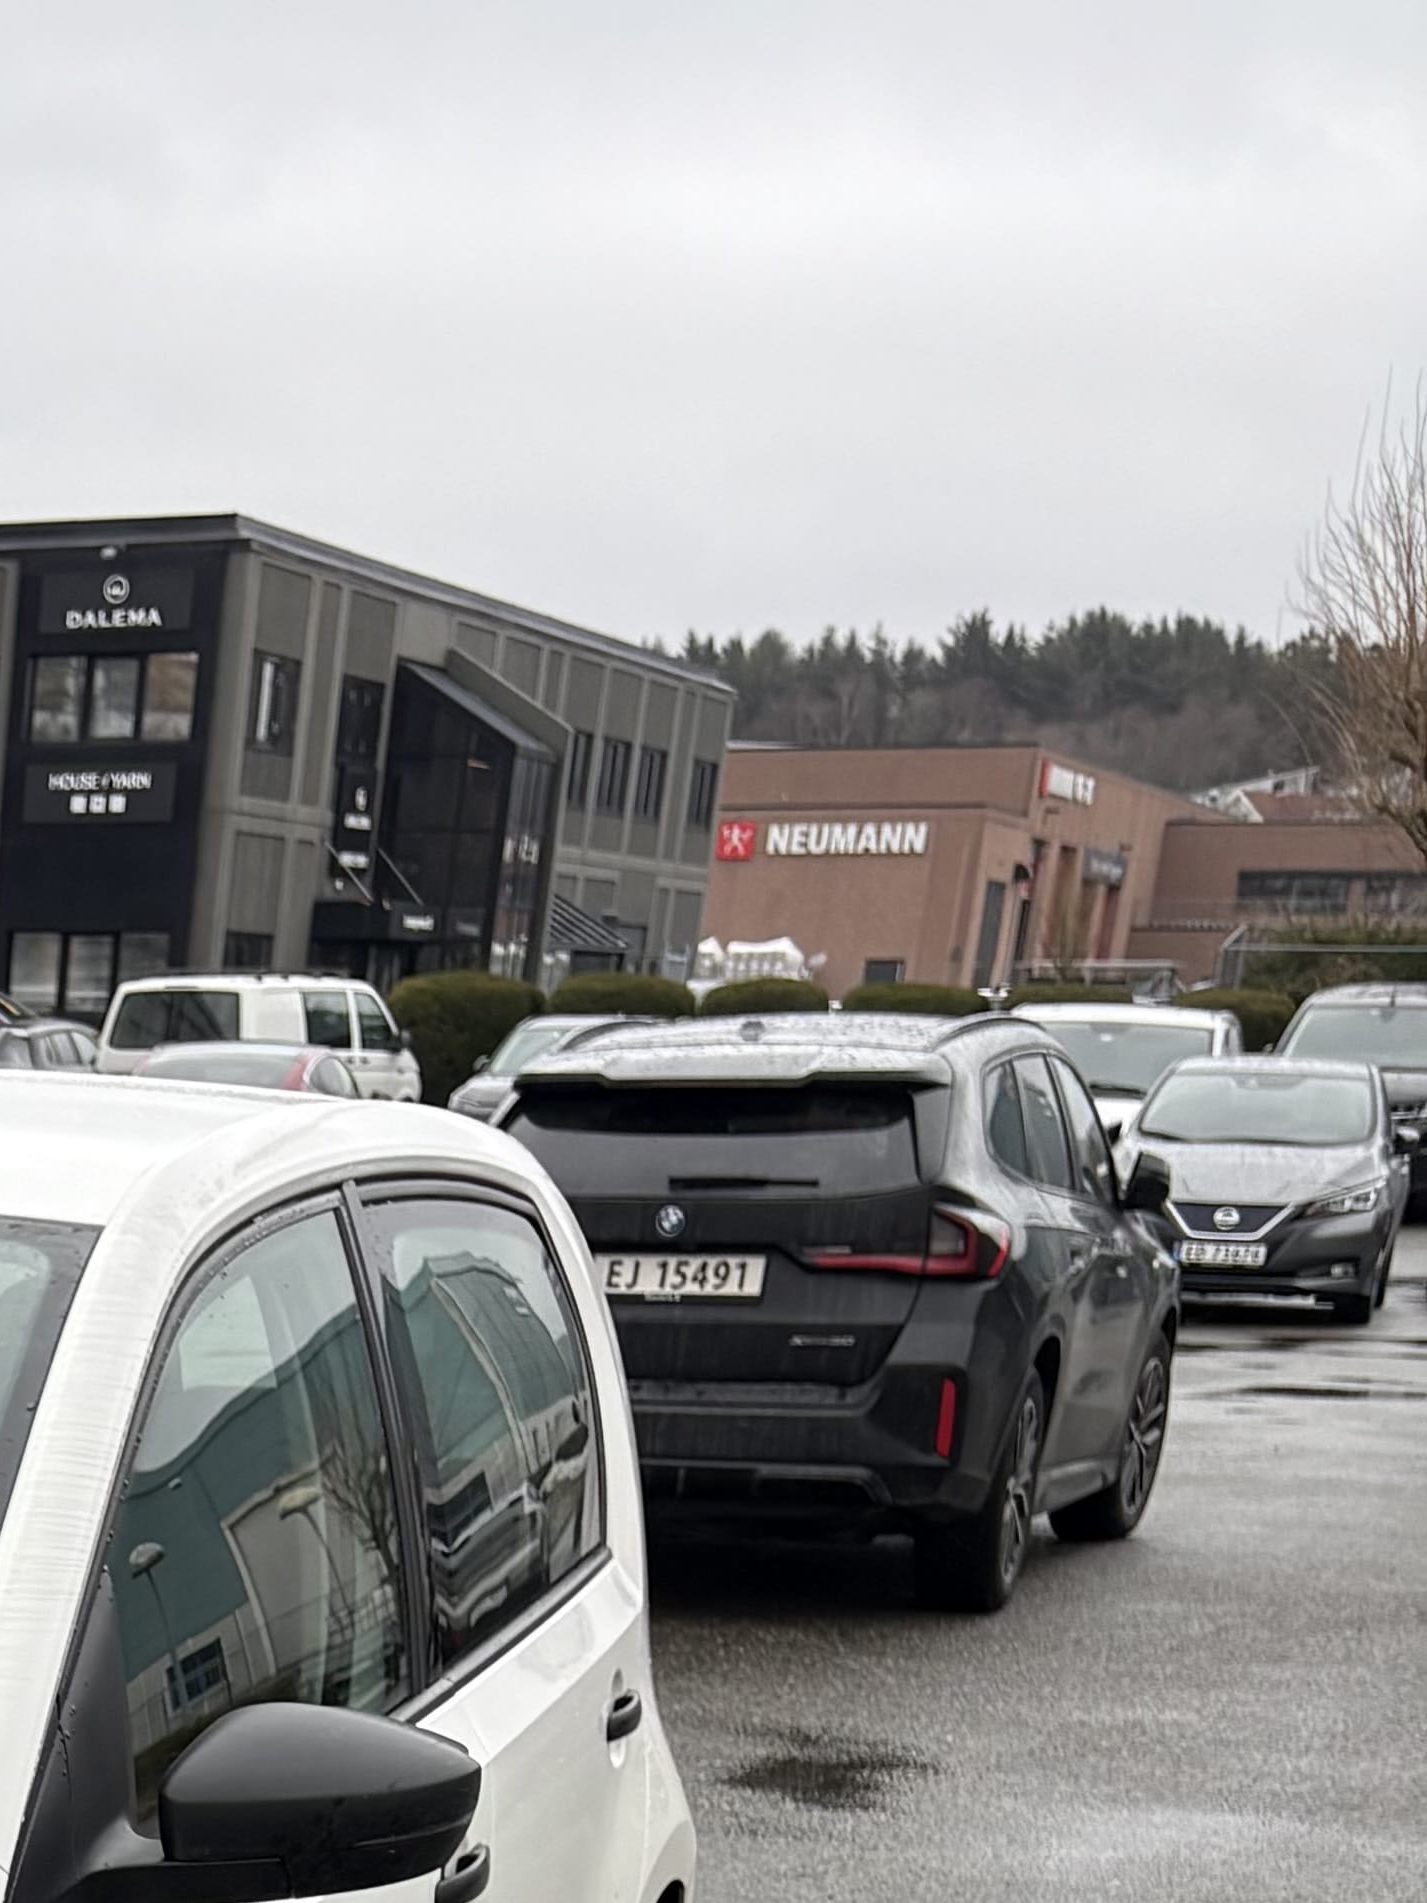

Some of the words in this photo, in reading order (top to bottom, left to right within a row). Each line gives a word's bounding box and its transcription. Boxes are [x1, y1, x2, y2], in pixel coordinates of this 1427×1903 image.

[65, 607, 163, 630] DALEMA
[766, 822, 928, 855] NEUMANN
[606, 1259, 640, 1289] EJ
[655, 1259, 749, 1292] 15491
